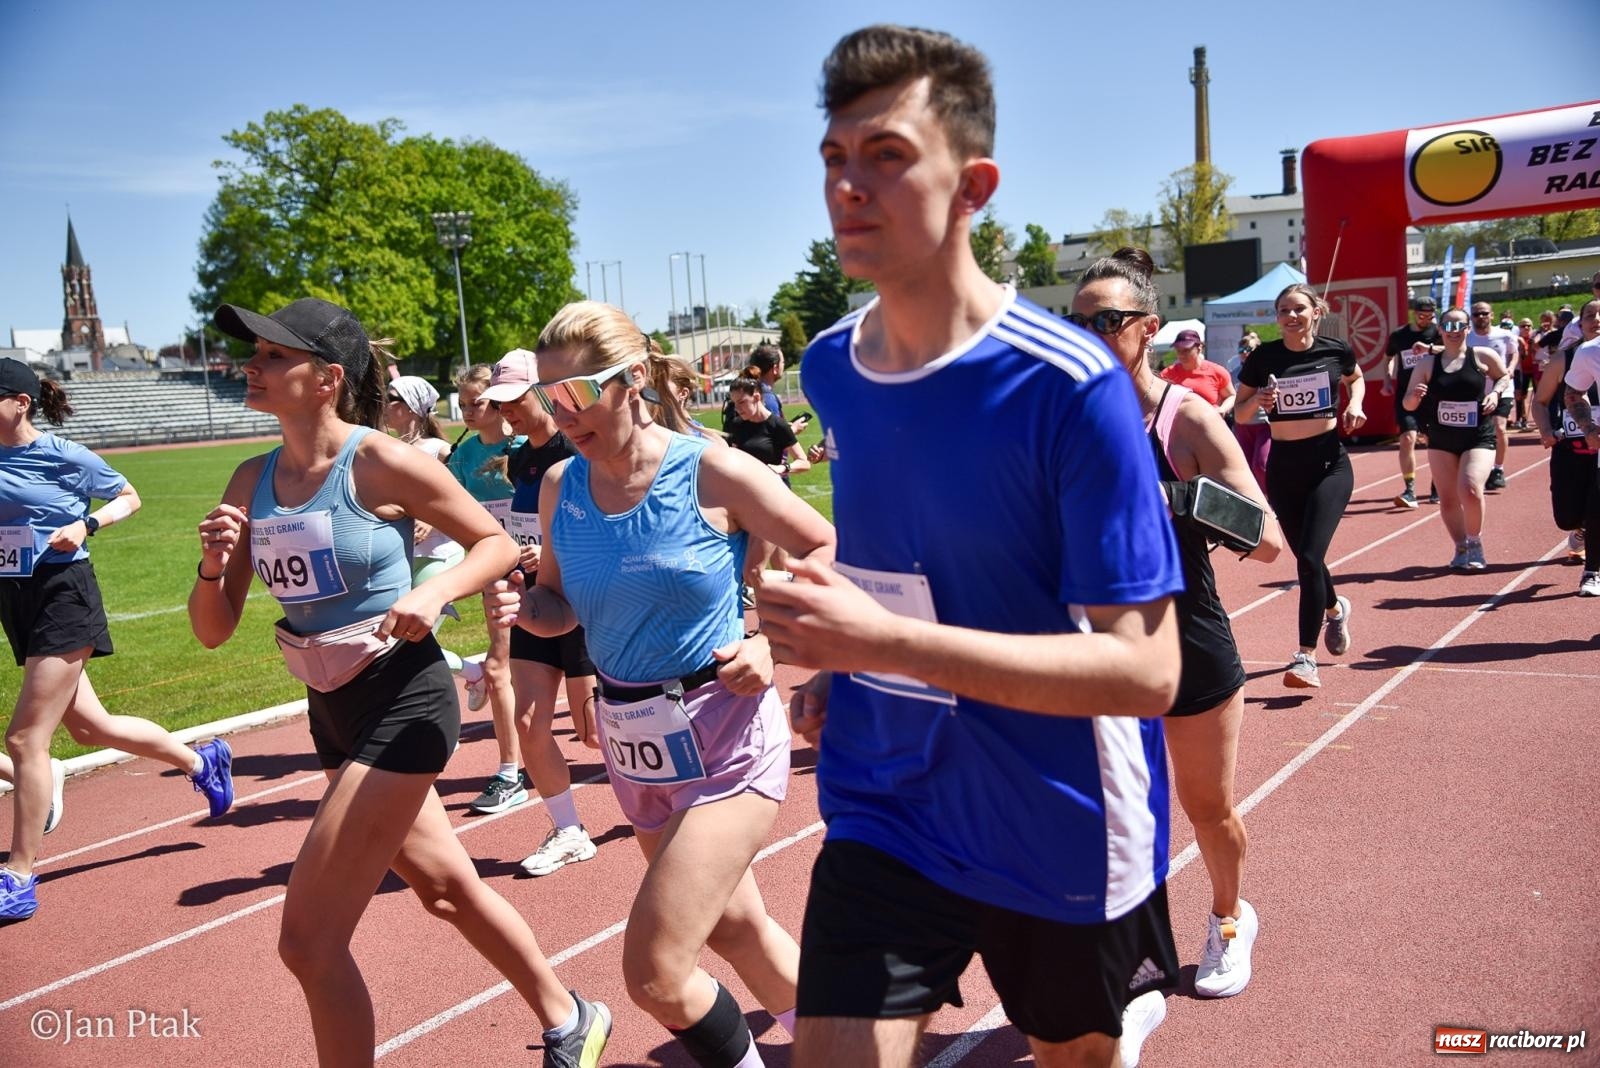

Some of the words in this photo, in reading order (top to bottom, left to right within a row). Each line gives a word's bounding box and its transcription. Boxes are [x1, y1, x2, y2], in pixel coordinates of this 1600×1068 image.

[1527, 137, 1598, 167] BEZ
[1283, 391, 1316, 407] 032
[1441, 412, 1467, 422] 055
[276, 521, 305, 534] GRANIC
[259, 555, 309, 589] 049
[624, 706, 655, 721] GRANIC
[608, 736, 664, 771] 070
